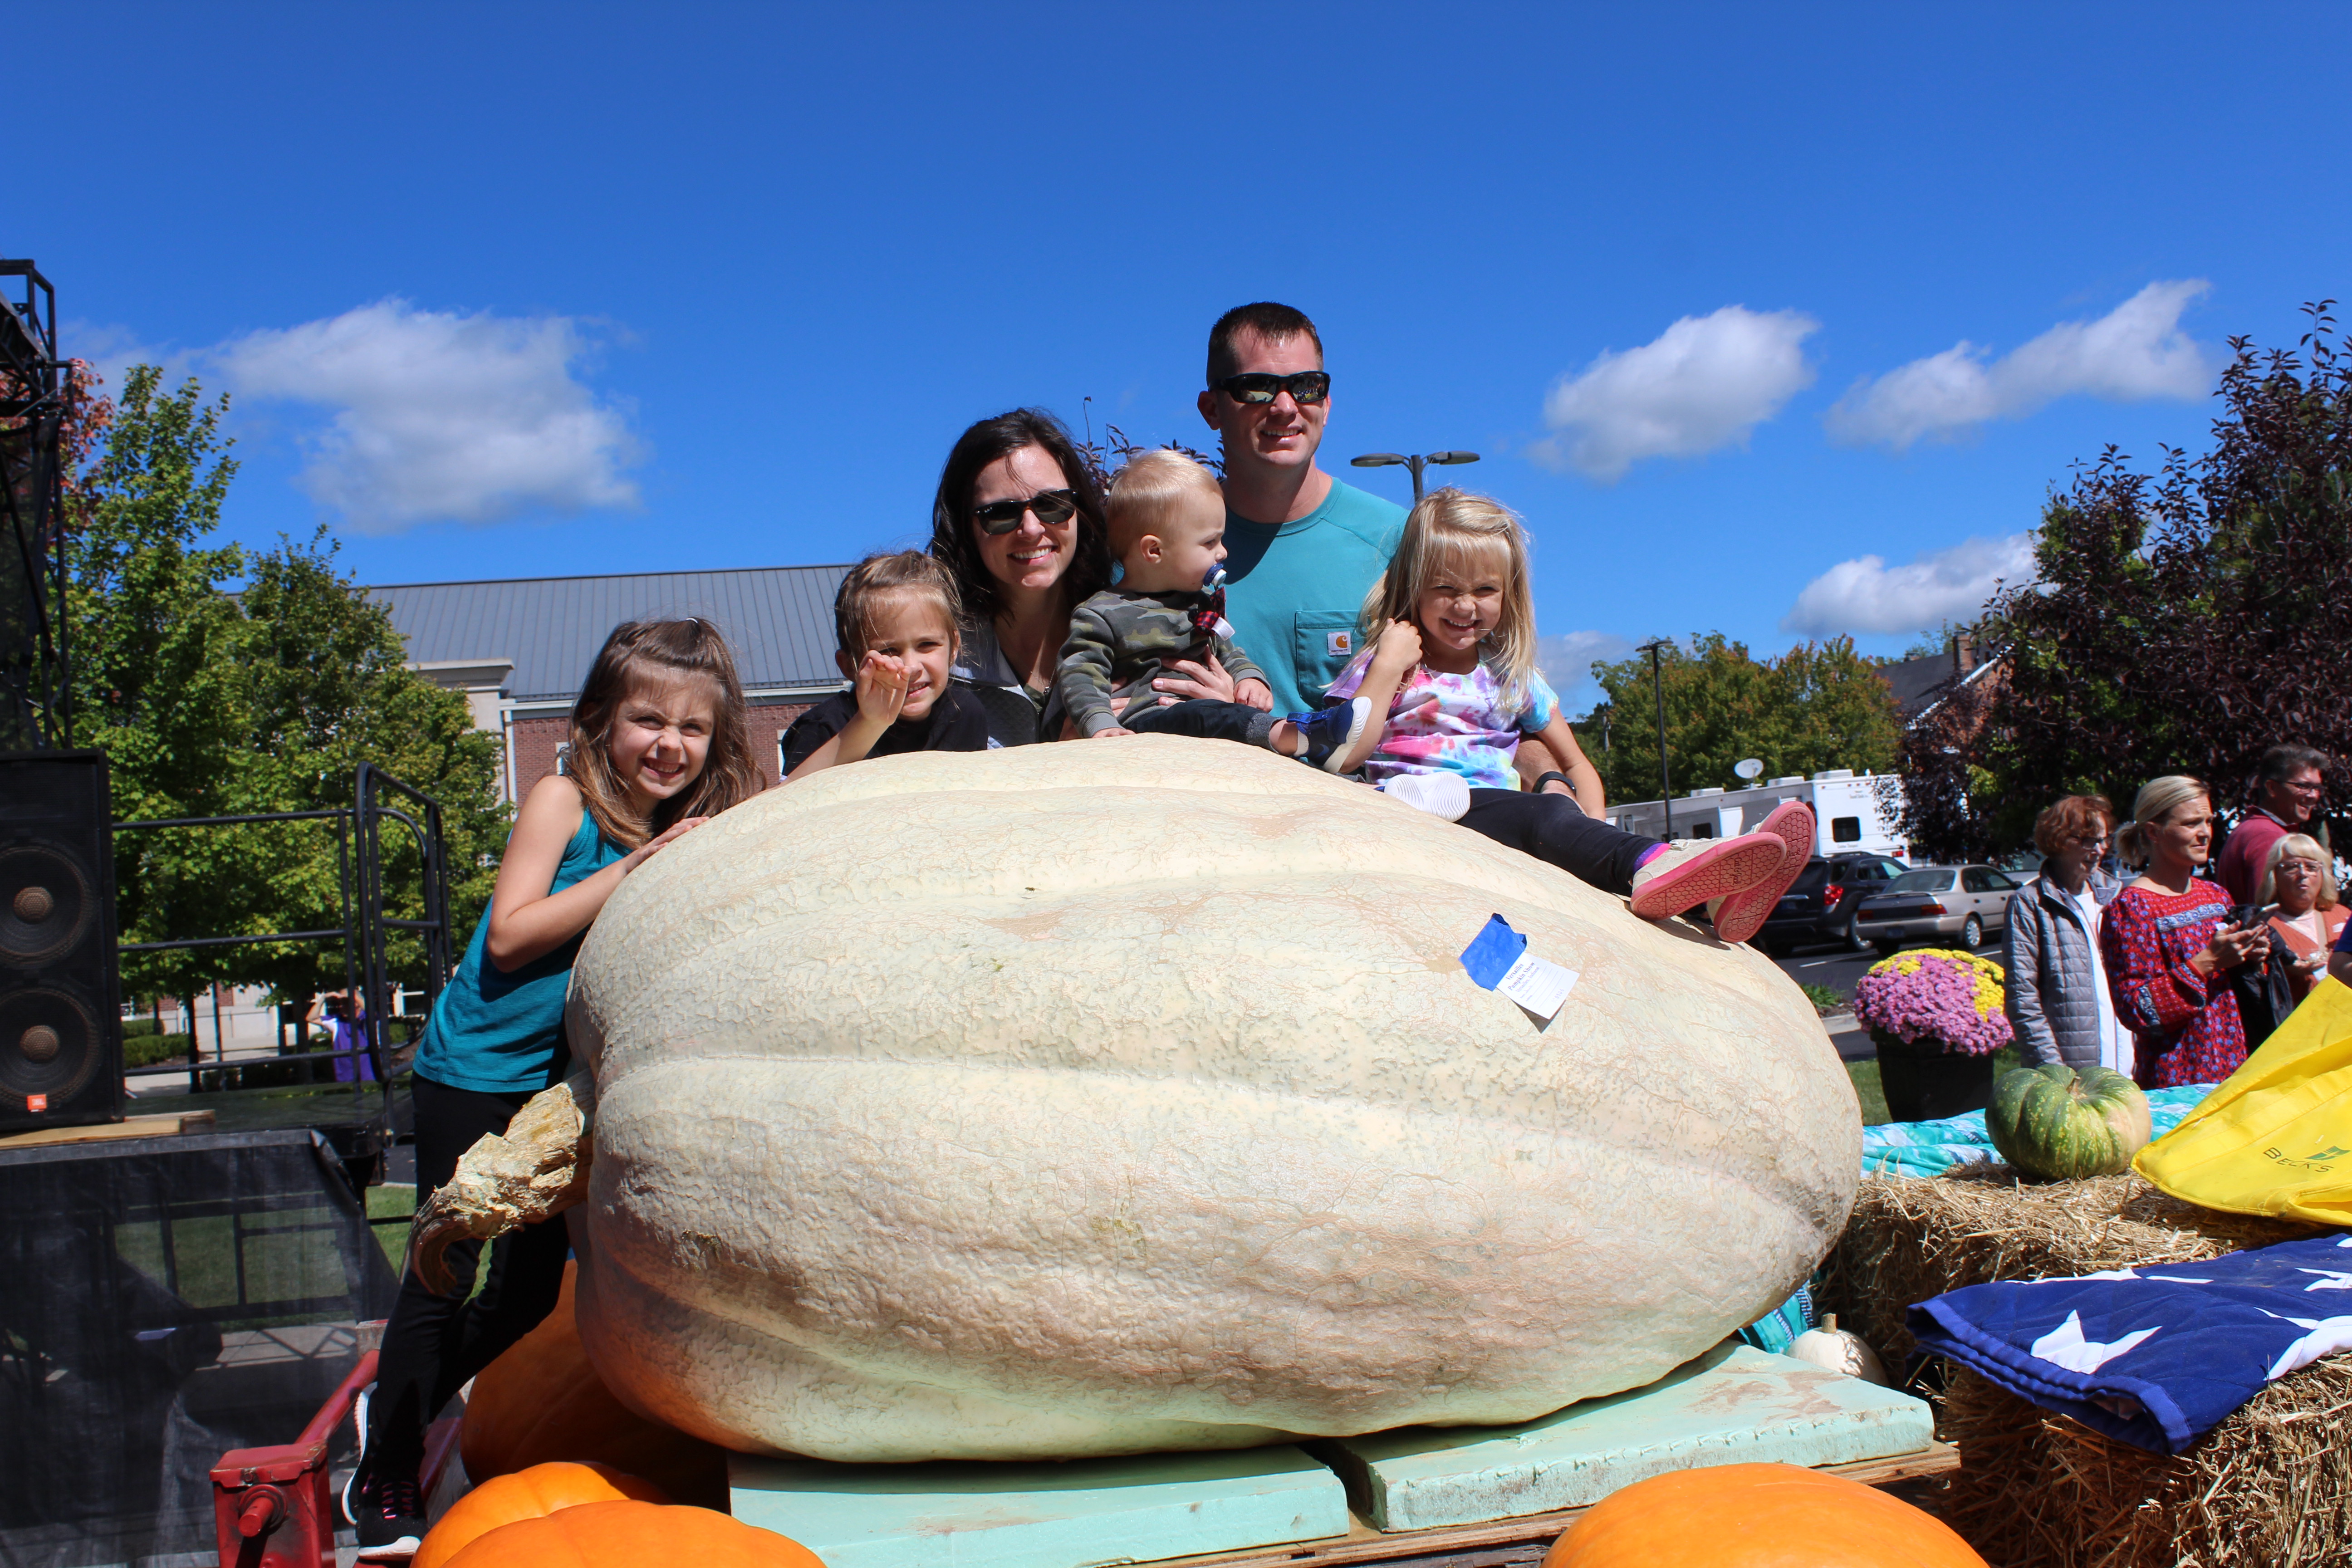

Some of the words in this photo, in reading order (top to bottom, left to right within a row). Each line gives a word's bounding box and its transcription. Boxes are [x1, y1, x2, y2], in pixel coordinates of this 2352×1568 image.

[1734, 857, 1742, 867] Cat
[1505, 964, 1524, 980] Versailles
[1508, 974, 1525, 990] Pumpkin
[1523, 962, 1535, 973] Show
[2263, 1147, 2334, 1172] BECK'S
